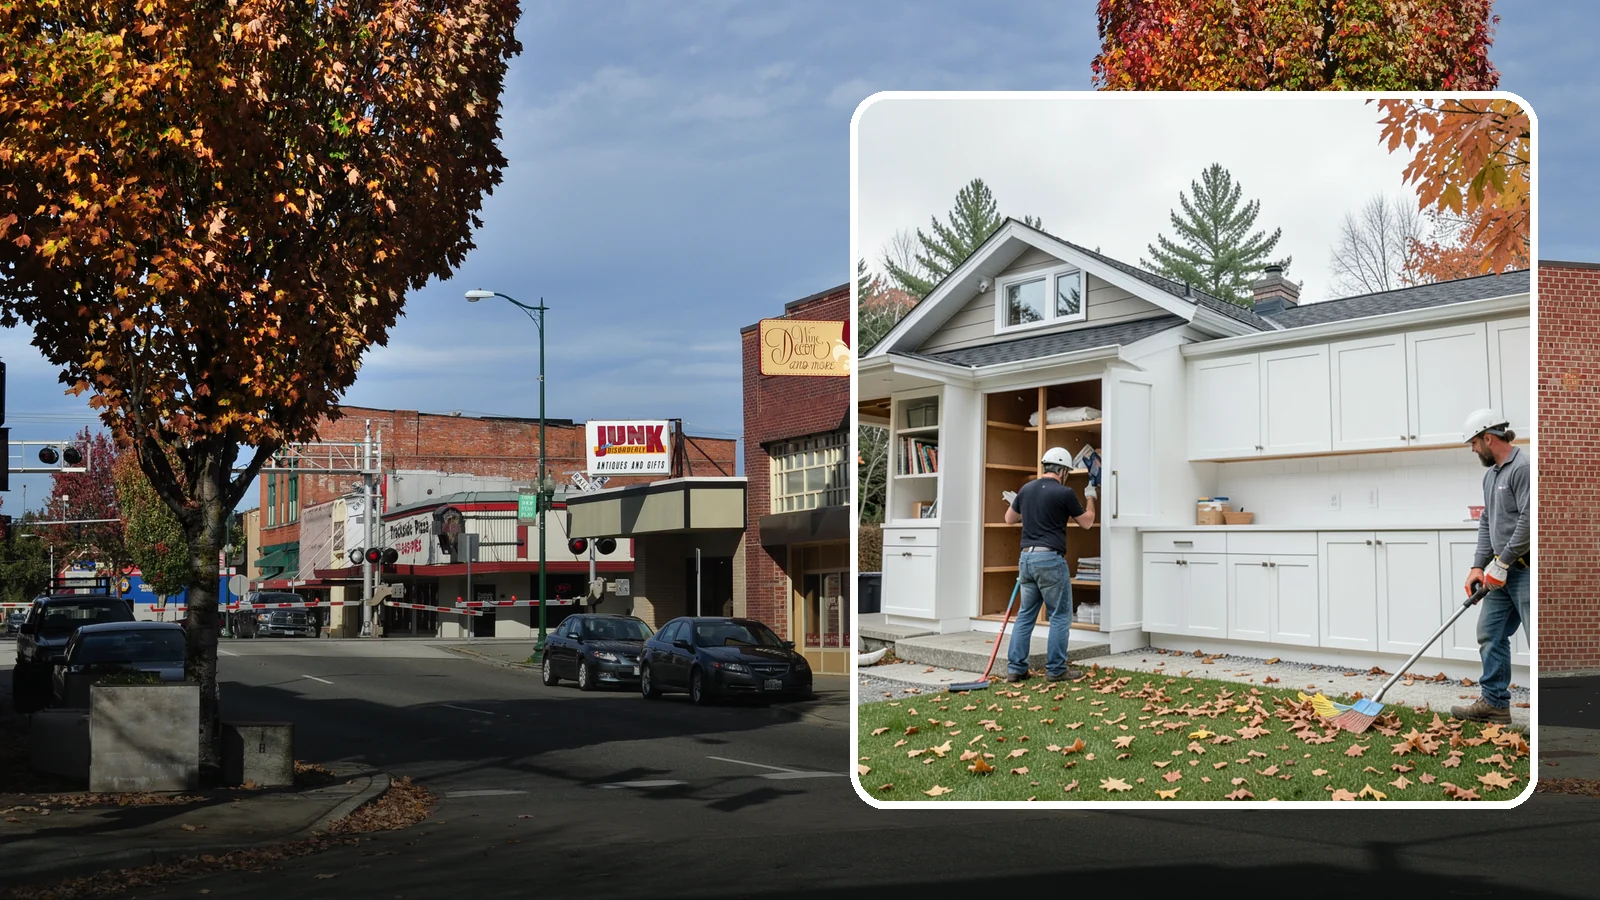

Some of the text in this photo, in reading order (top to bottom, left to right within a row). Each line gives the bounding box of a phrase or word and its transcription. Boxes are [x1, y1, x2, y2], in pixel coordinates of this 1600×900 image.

[595, 425, 664, 457] JUNK
[607, 446, 646, 454] DISORDERLY
[596, 460, 665, 470] ANTIQUES AND GIFTS
[414, 519, 429, 535] Pizza
